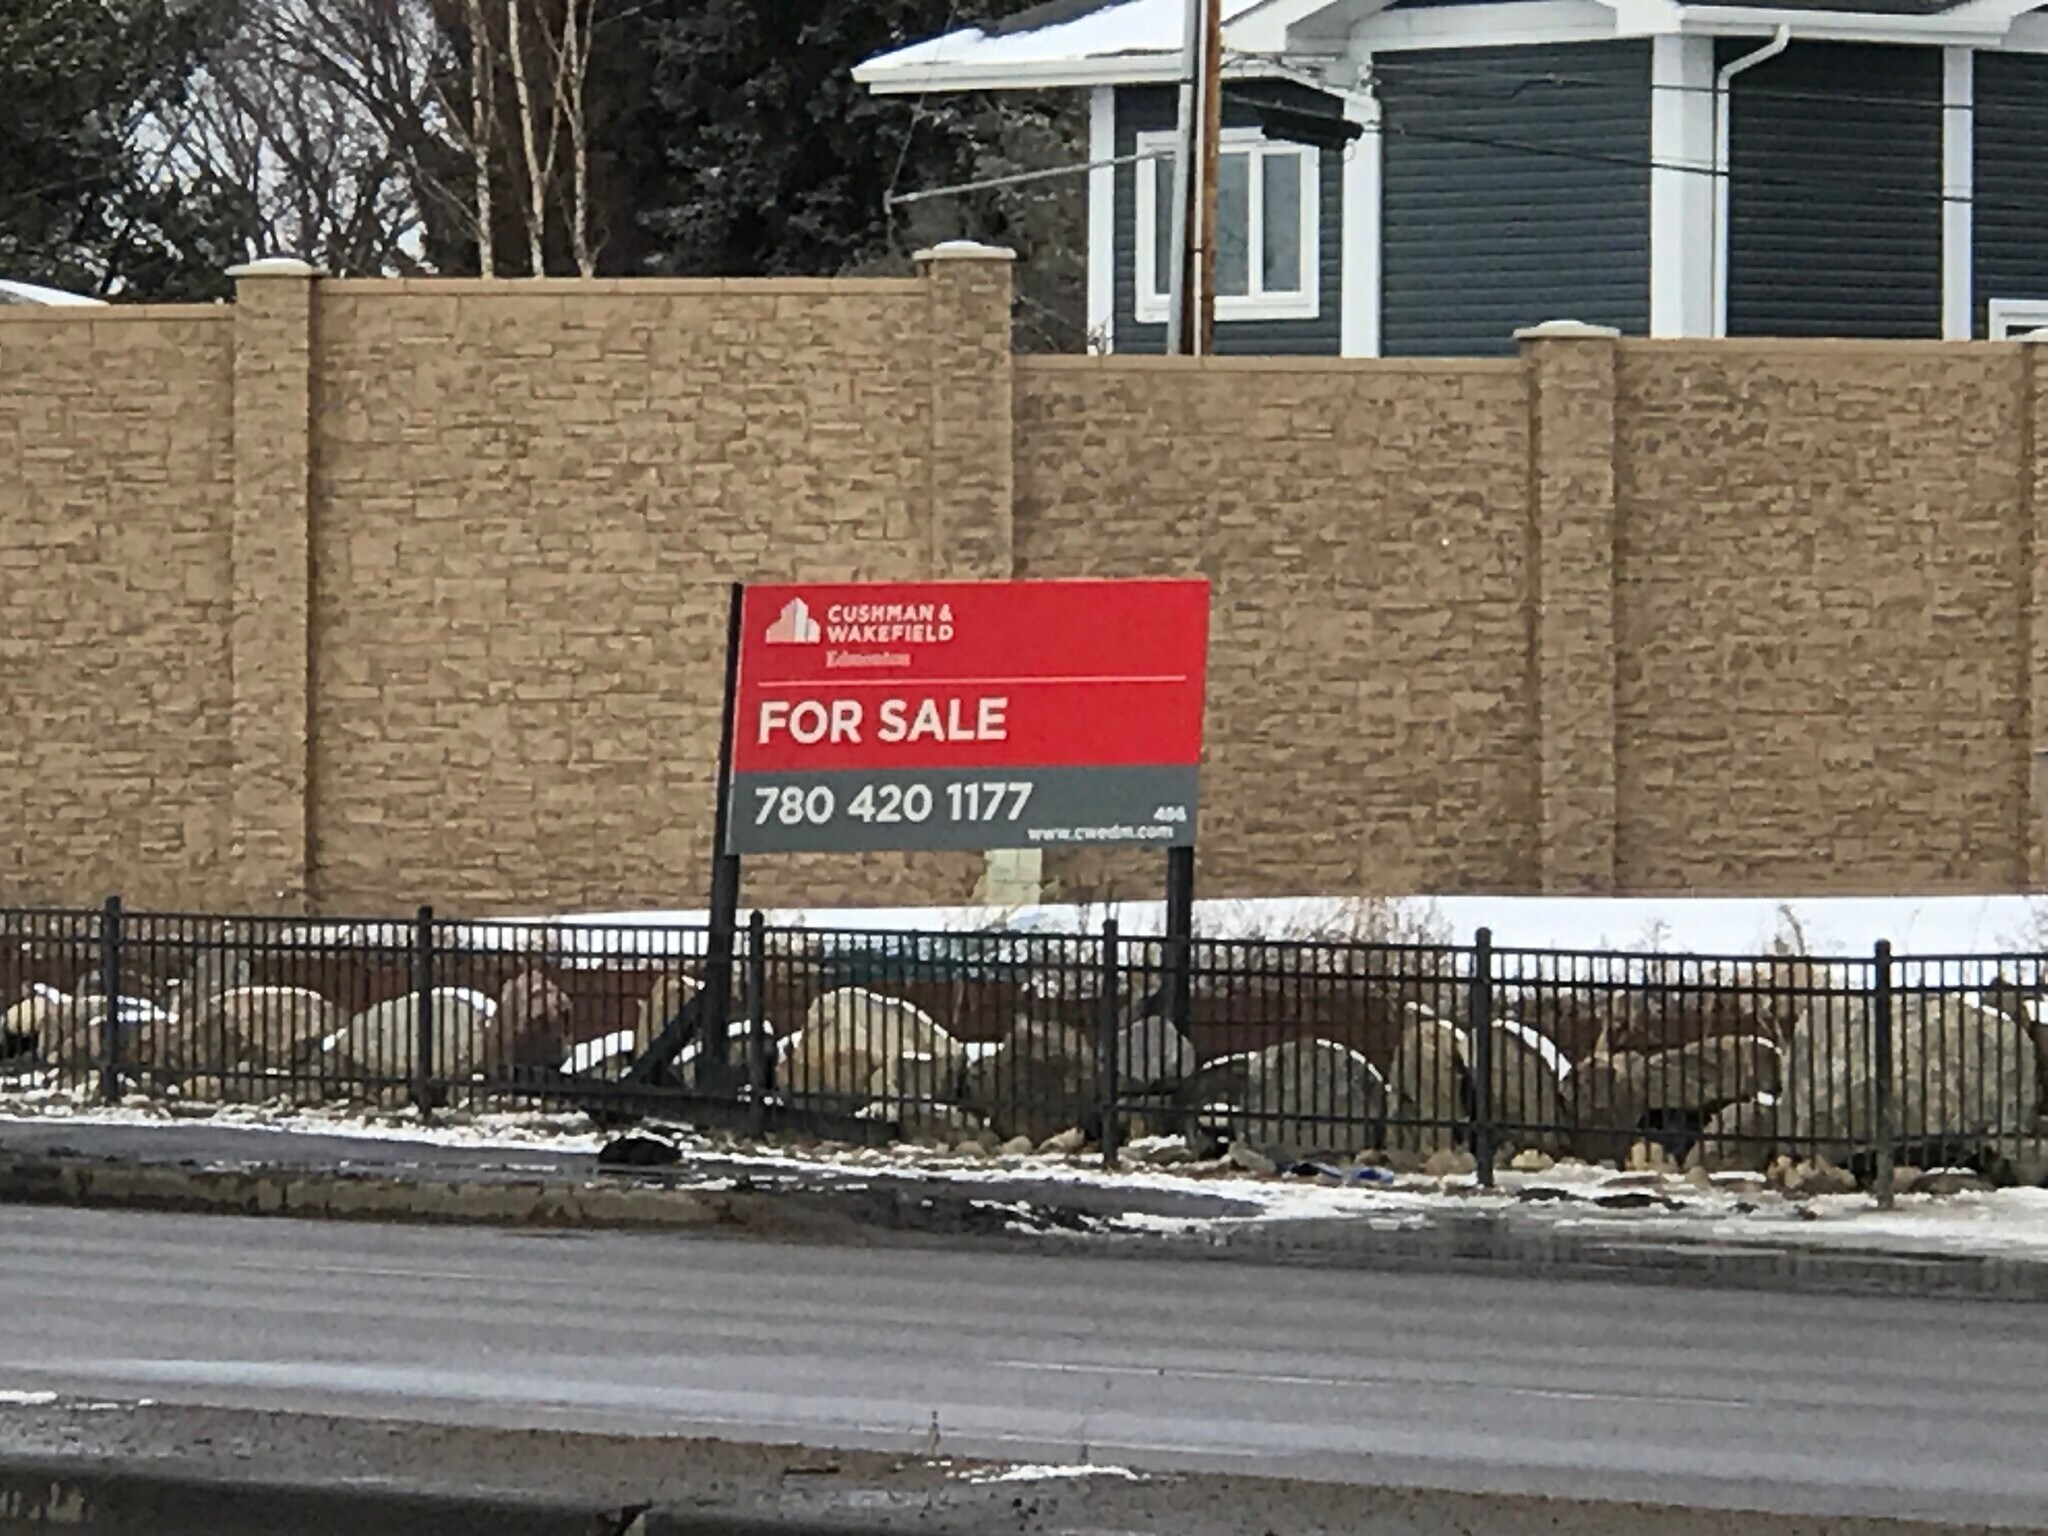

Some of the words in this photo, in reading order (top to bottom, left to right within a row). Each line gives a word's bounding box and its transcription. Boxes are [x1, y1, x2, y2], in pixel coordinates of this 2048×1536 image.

[827, 604, 934, 622] CUSHMAN
[938, 603, 954, 622] &
[826, 624, 954, 643] WAKEFIELD
[758, 700, 863, 744] FOR
[878, 697, 1008, 742] SALE
[755, 786, 834, 825] 780
[847, 783, 933, 822] 420
[946, 782, 1033, 821] 1177
